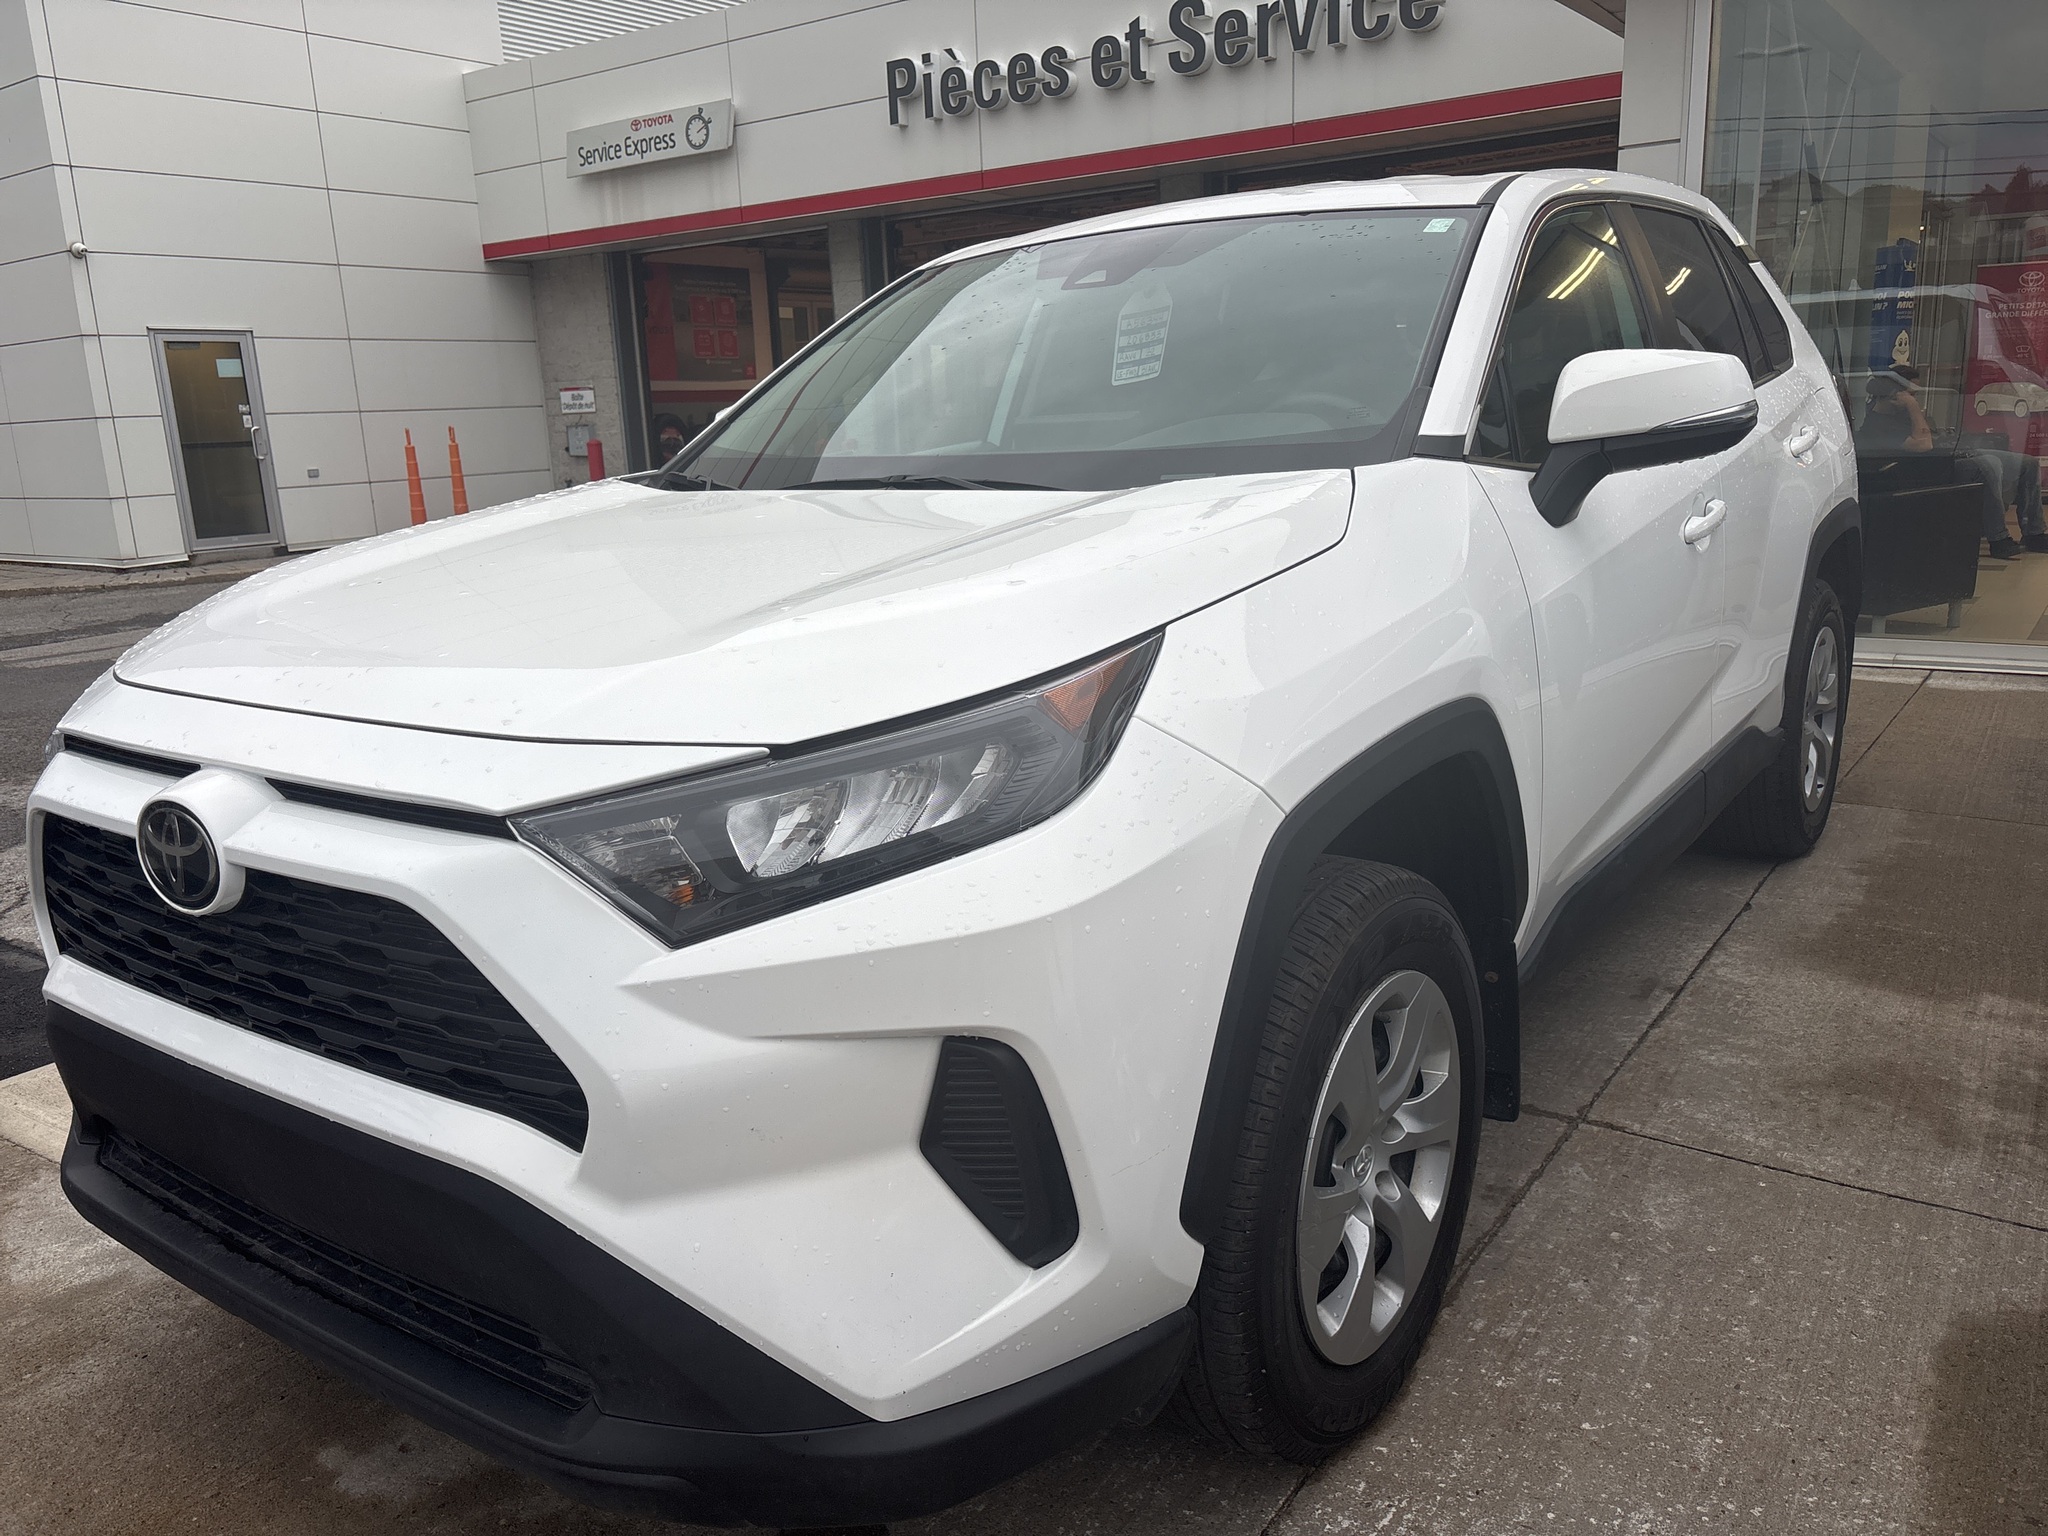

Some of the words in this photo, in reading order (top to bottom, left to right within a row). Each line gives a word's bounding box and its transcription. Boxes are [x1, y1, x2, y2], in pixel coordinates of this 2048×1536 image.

[885, 45, 1077, 127] Pièces
[1091, 15, 1154, 90] et
[642, 114, 674, 129] TOYOTA
[577, 141, 622, 167] Service
[624, 132, 676, 160] Express
[1998, 302, 2025, 310] PETITS
[1985, 311, 2020, 319] GRANDE
